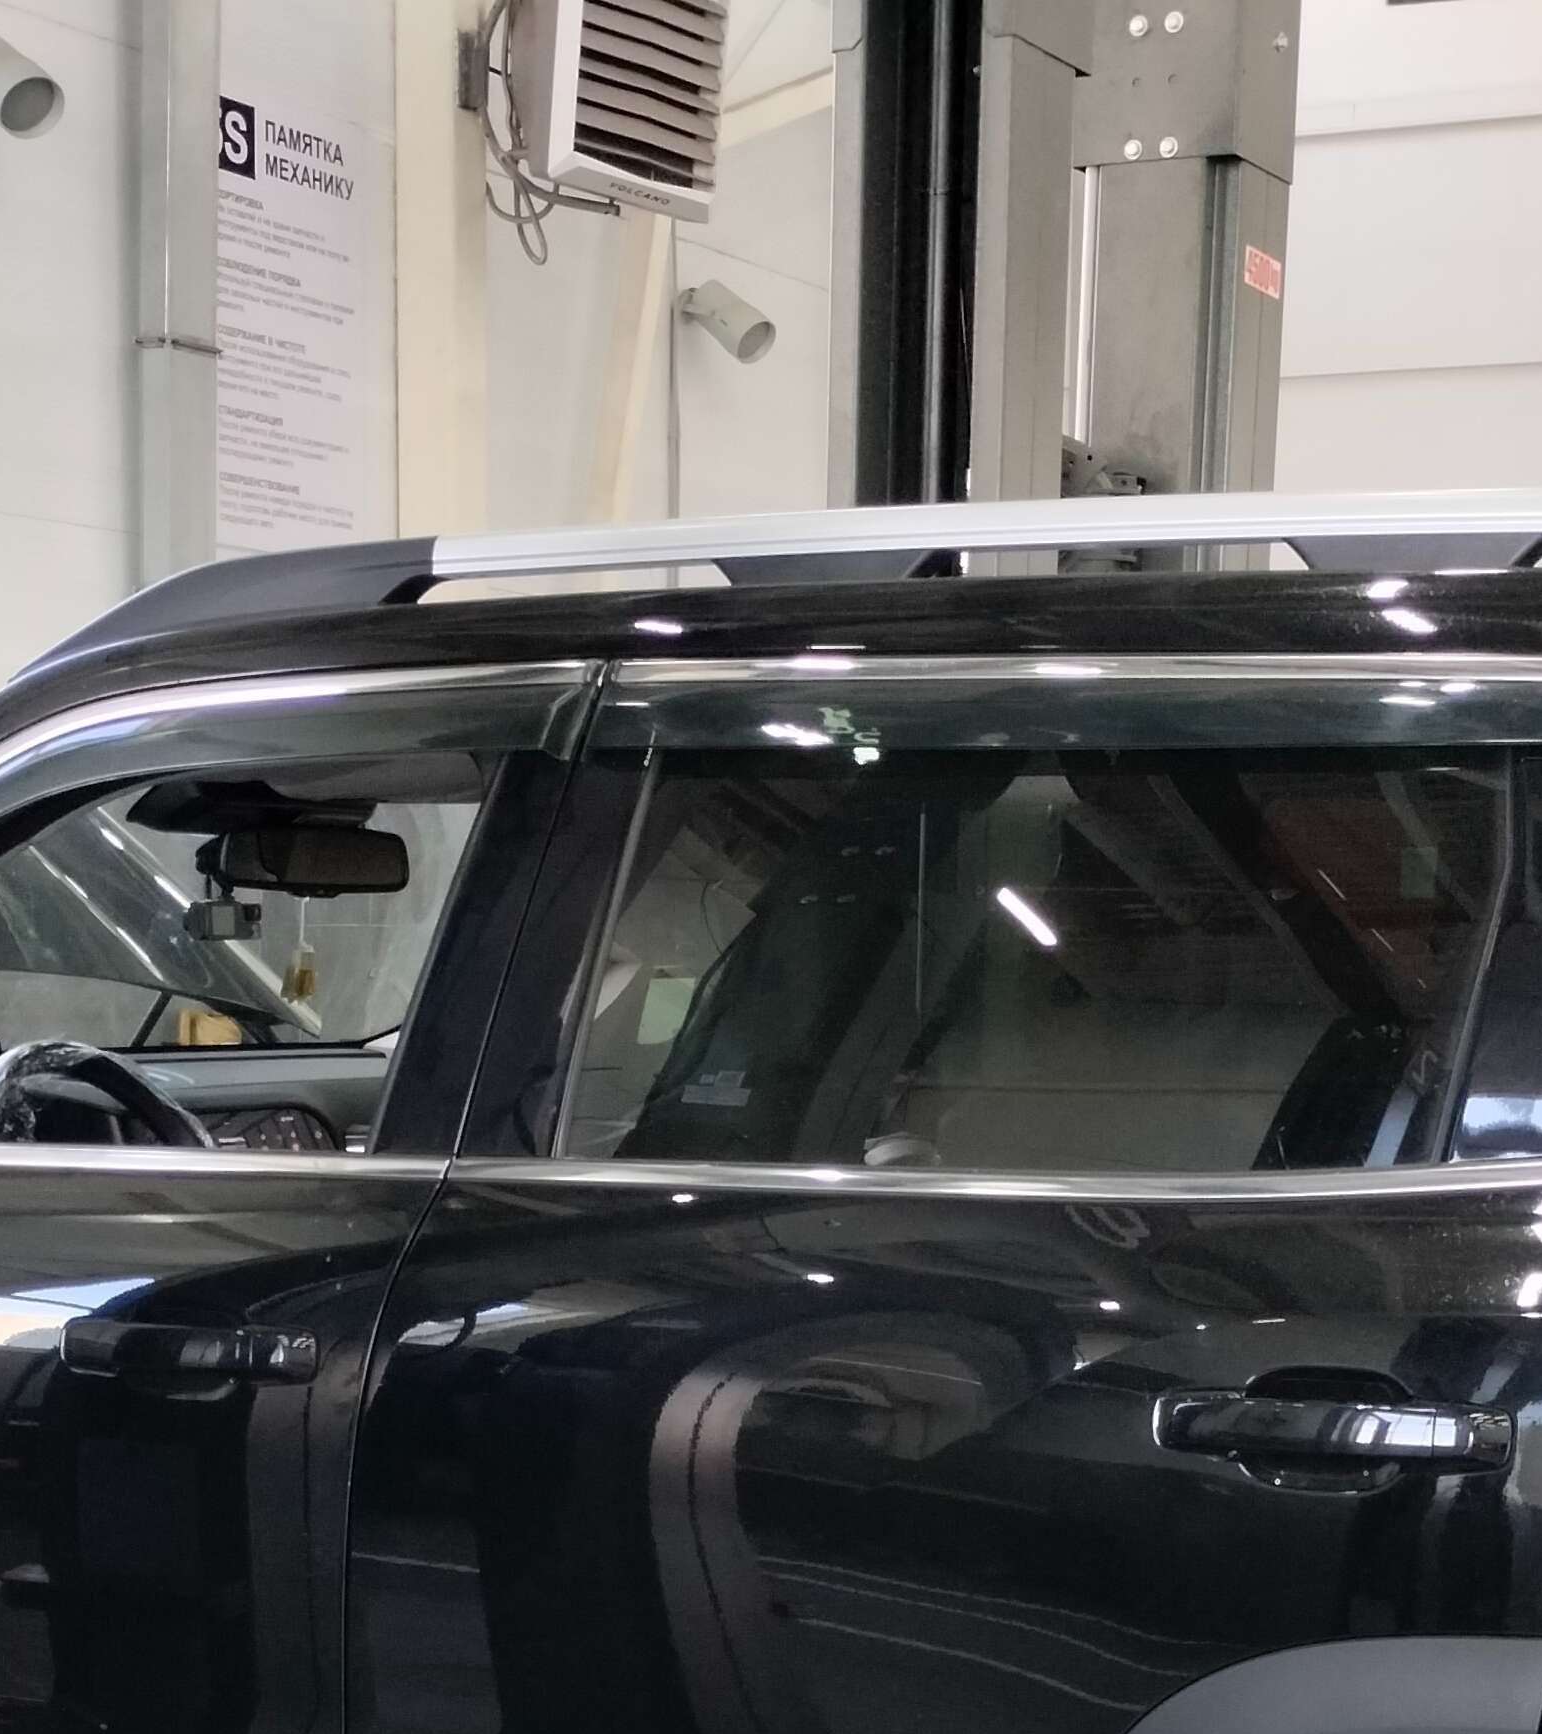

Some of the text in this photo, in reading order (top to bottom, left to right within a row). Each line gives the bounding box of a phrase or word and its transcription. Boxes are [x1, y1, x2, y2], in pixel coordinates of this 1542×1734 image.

[219, 108, 249, 165] S
[265, 119, 344, 167] ПАМЯТКА
[265, 153, 355, 201] МЕХАНИКУ
